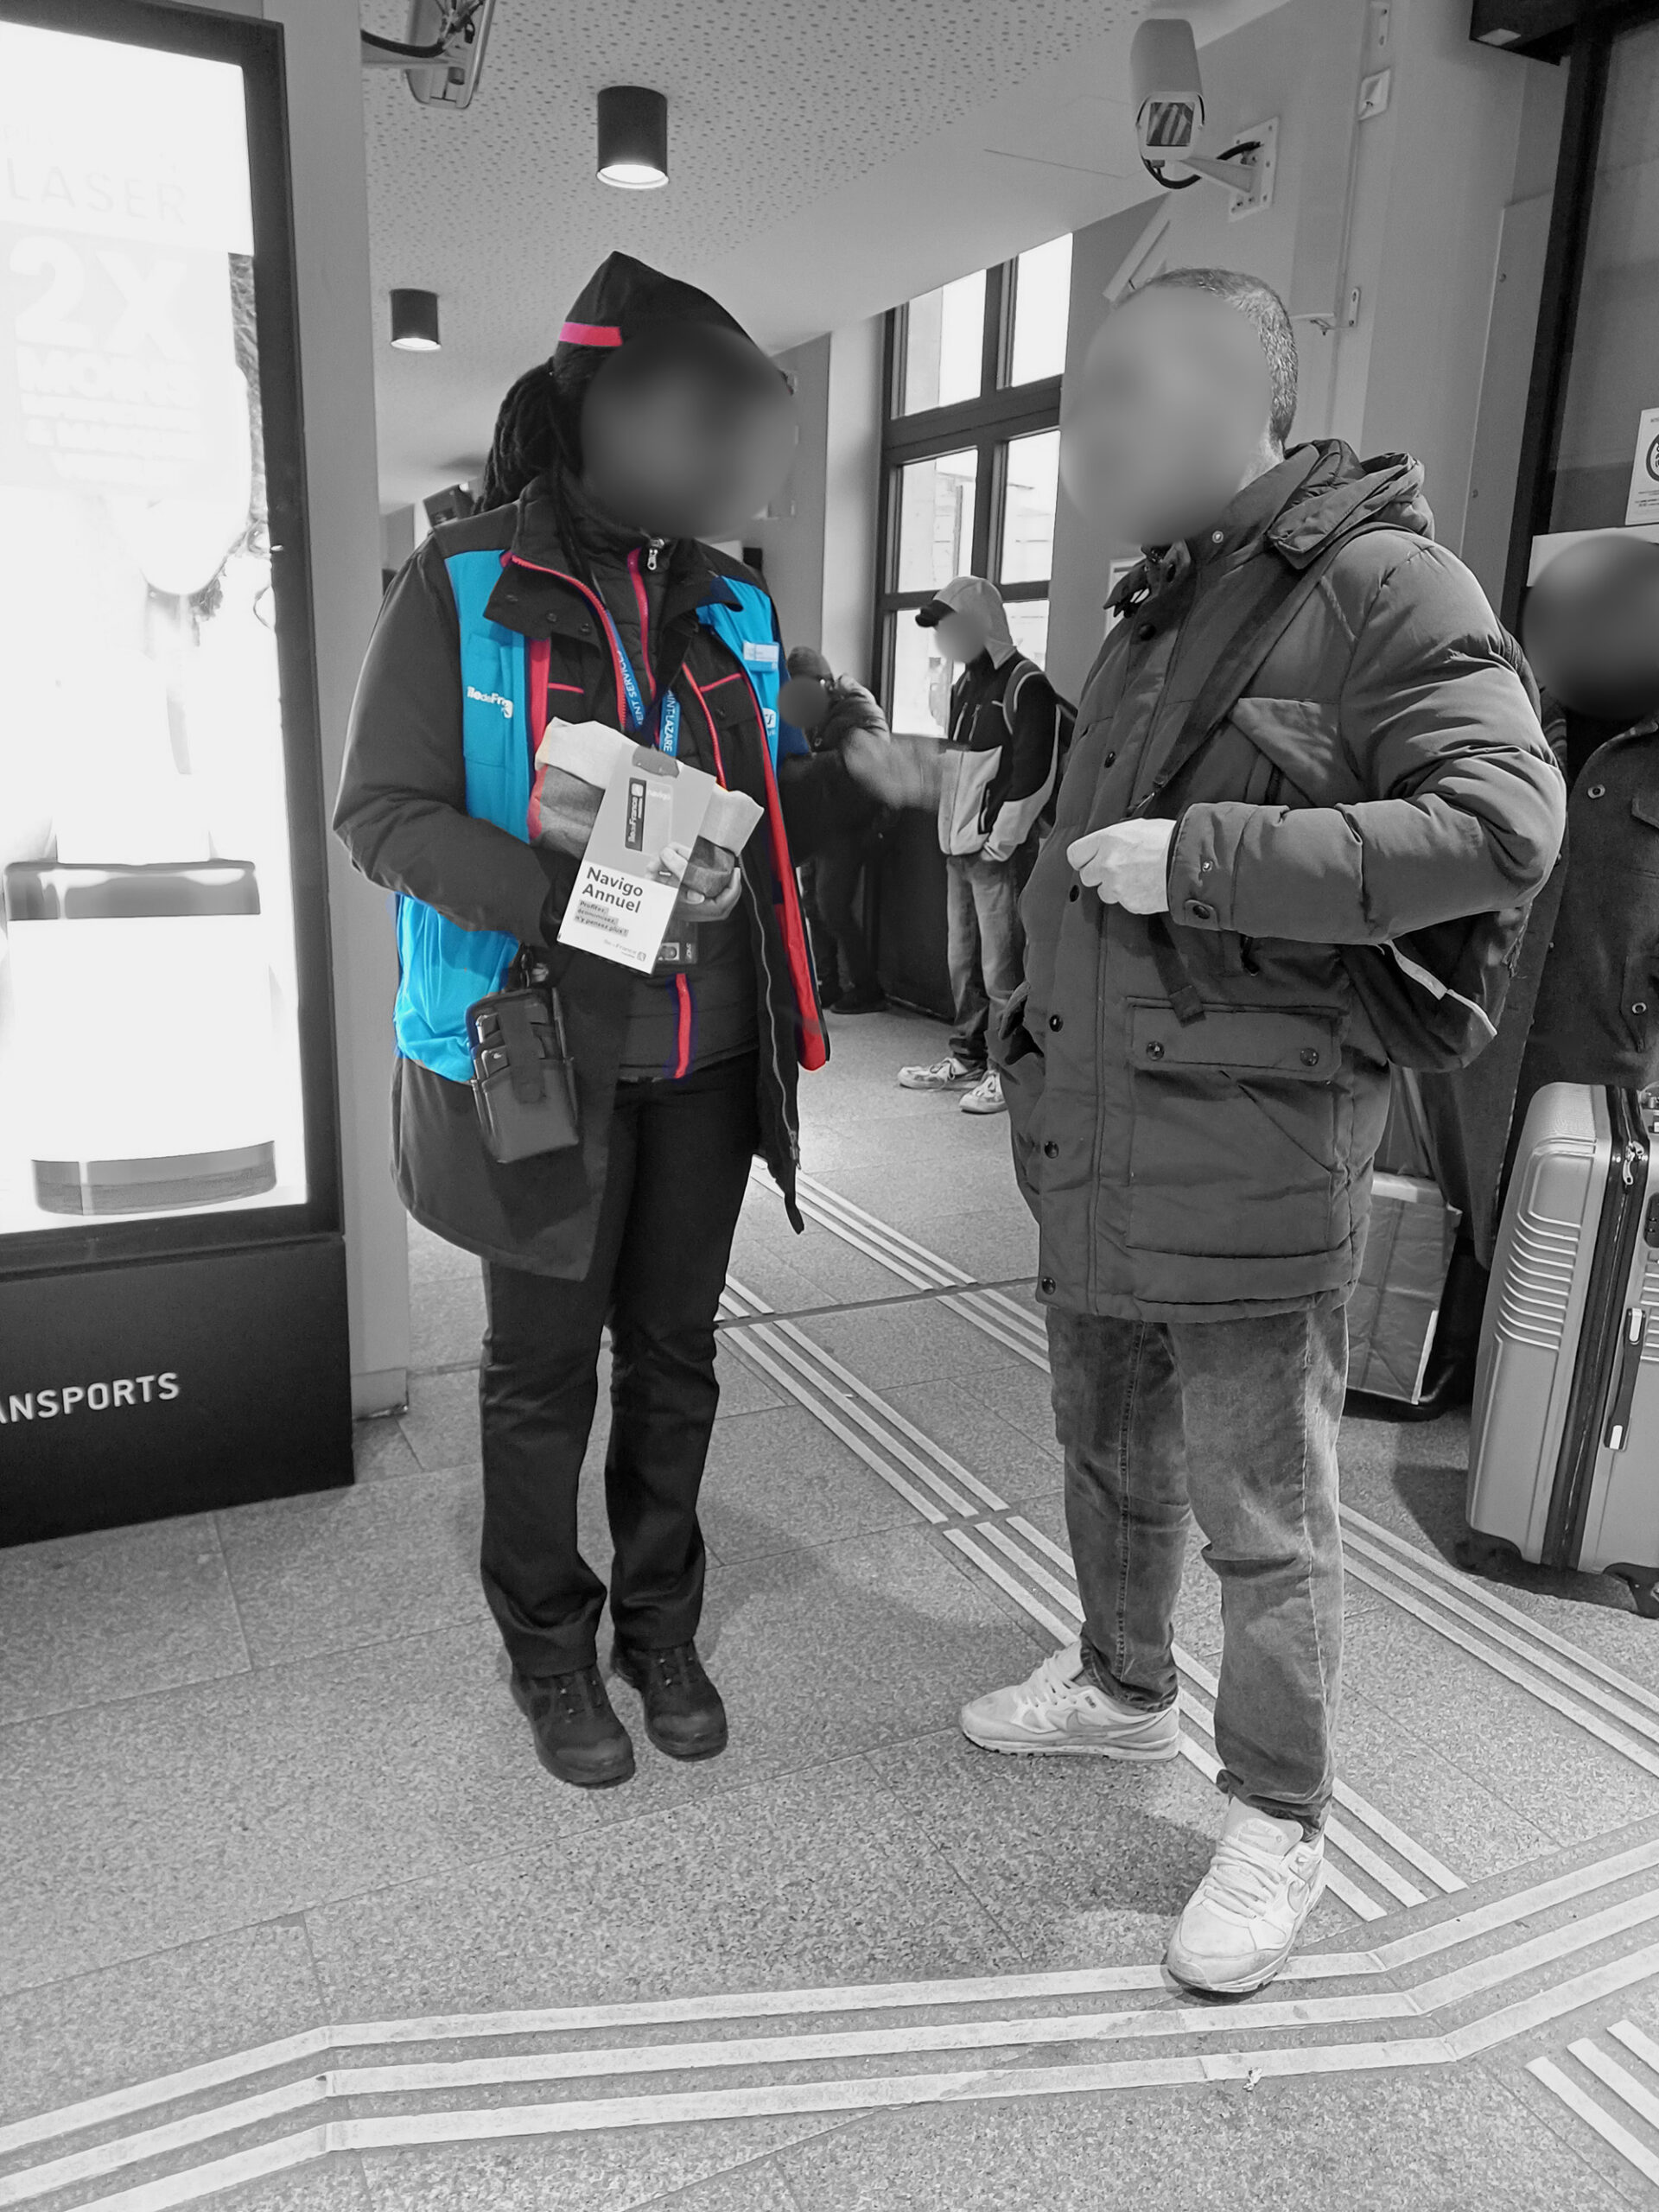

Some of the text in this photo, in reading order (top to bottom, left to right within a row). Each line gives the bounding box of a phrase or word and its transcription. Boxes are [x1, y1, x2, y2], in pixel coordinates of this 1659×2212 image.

[6, 157, 187, 225] LASER
[10, 236, 195, 363] 2X
[582, 883, 641, 913] Annuel
[587, 867, 643, 897] Navigo
